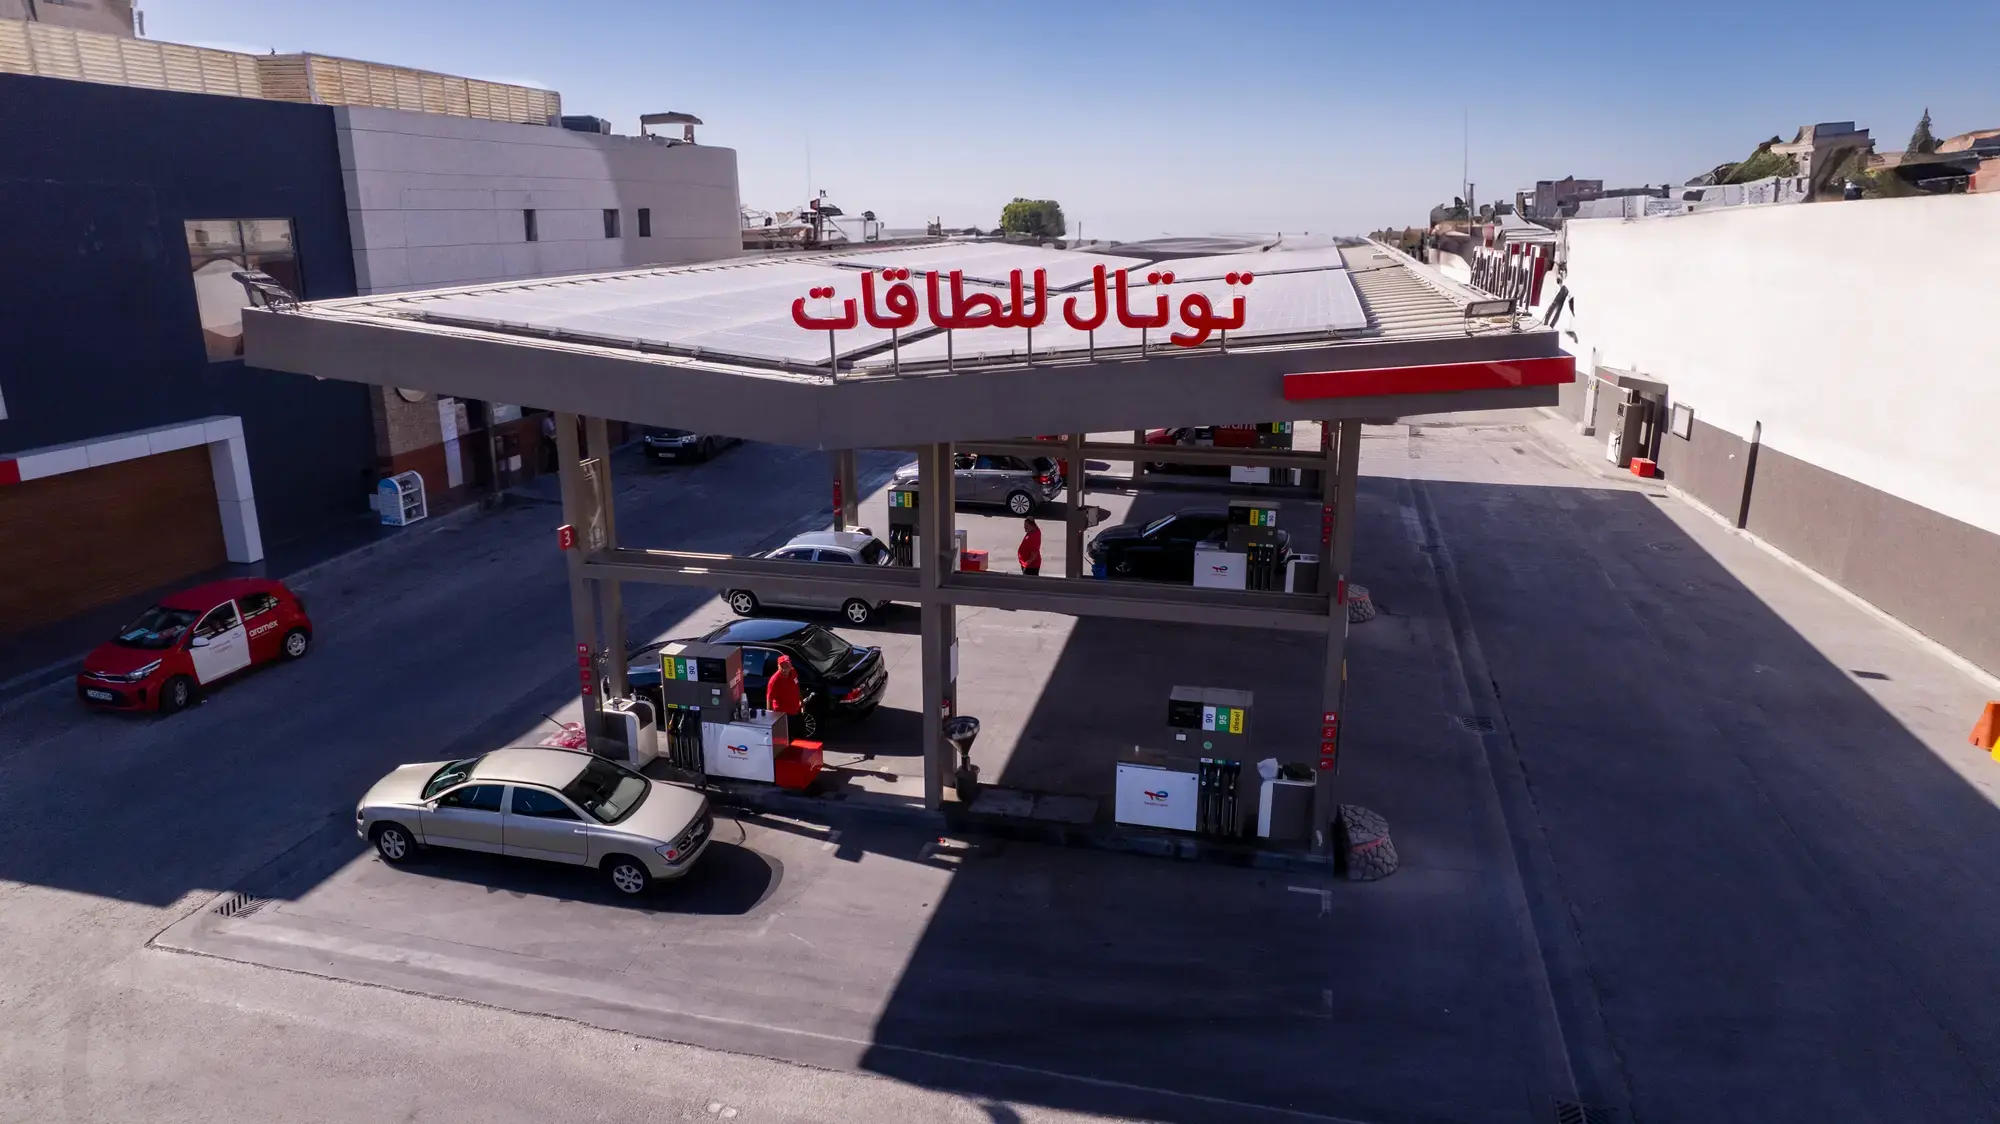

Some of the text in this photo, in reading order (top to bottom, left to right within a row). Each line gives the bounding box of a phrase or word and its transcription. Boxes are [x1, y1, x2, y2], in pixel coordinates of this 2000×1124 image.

[791, 264, 1255, 347] توتال للطاقات
[564, 530, 571, 546] 3
[249, 620, 279, 637] aramex
[677, 664, 685, 674] 95
[688, 665, 696, 675] 90
[1205, 713, 1214, 724] 90
[1218, 714, 1227, 725] 95
[1232, 711, 1241, 731] diesel
